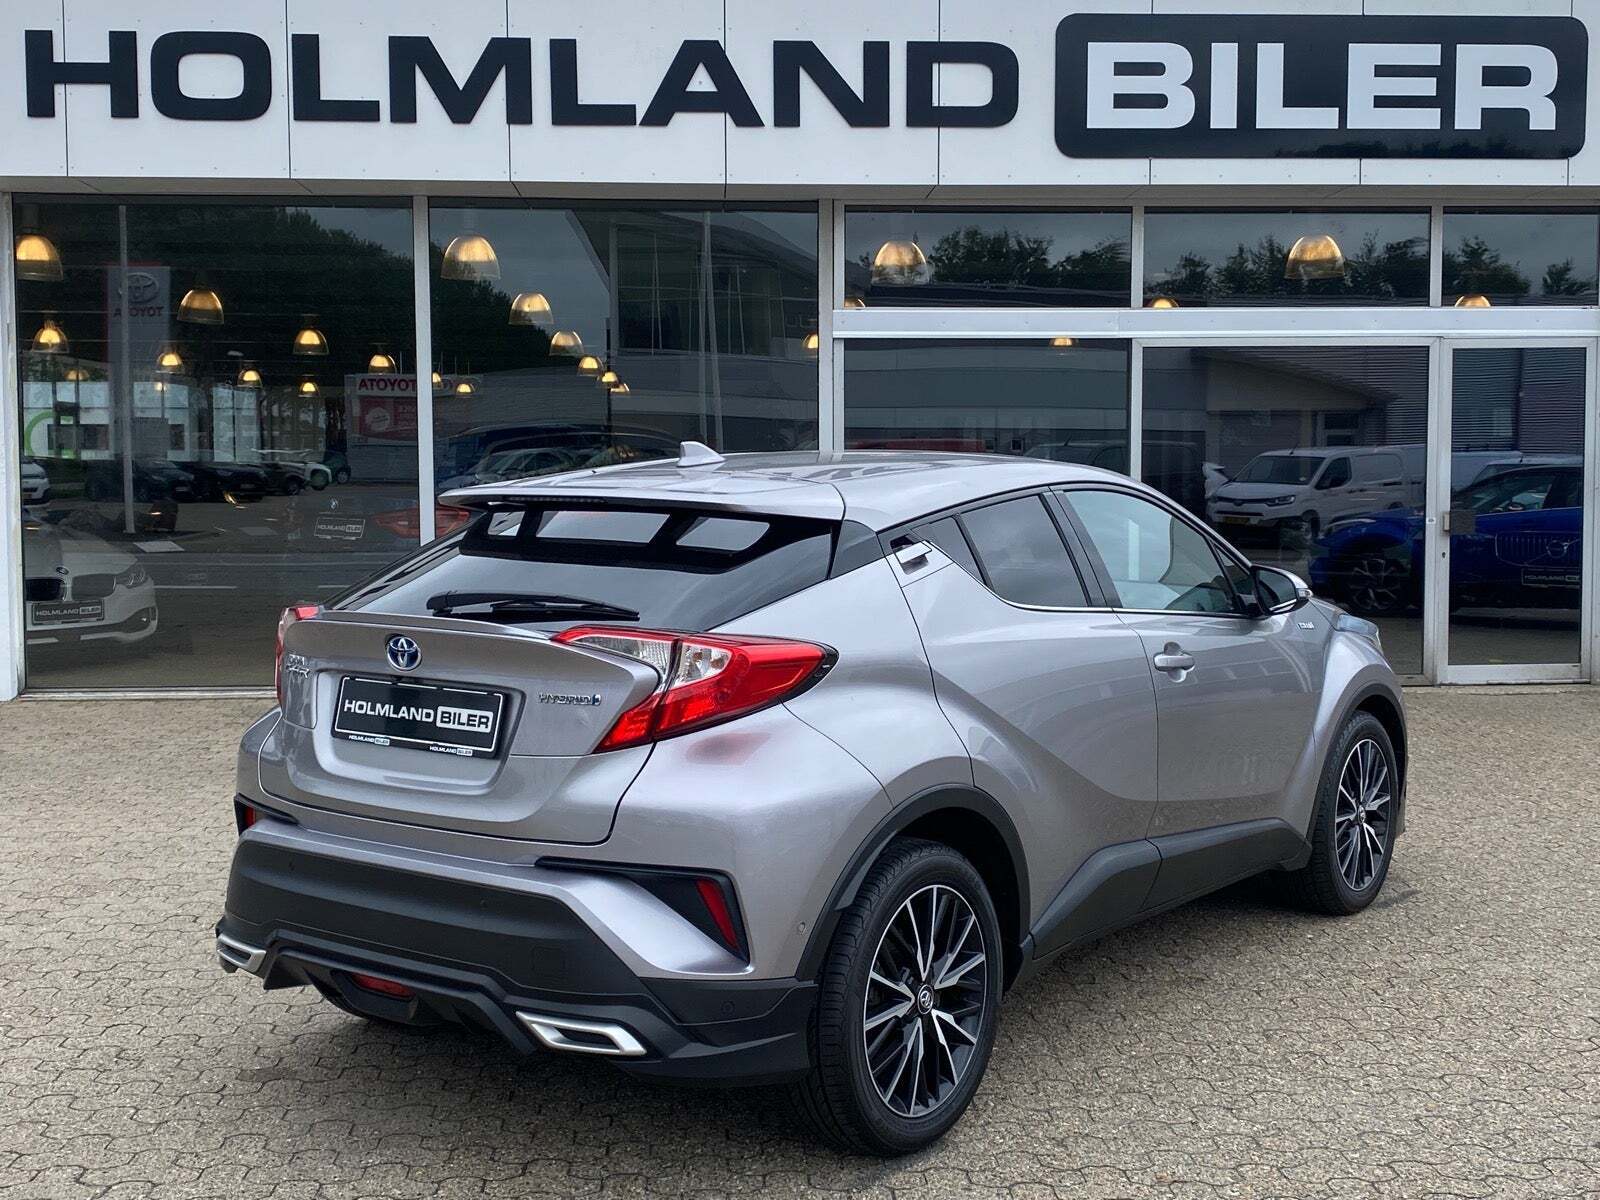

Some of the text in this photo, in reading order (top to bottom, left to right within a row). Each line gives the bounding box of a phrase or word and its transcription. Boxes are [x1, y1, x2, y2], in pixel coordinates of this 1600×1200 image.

[25, 29, 1559, 131] HOLMLAND BILER
[343, 699, 491, 730] HOLMLAND BILER
[348, 734, 375, 743] HOLMLAND
[429, 745, 457, 754] HOLMLAND
